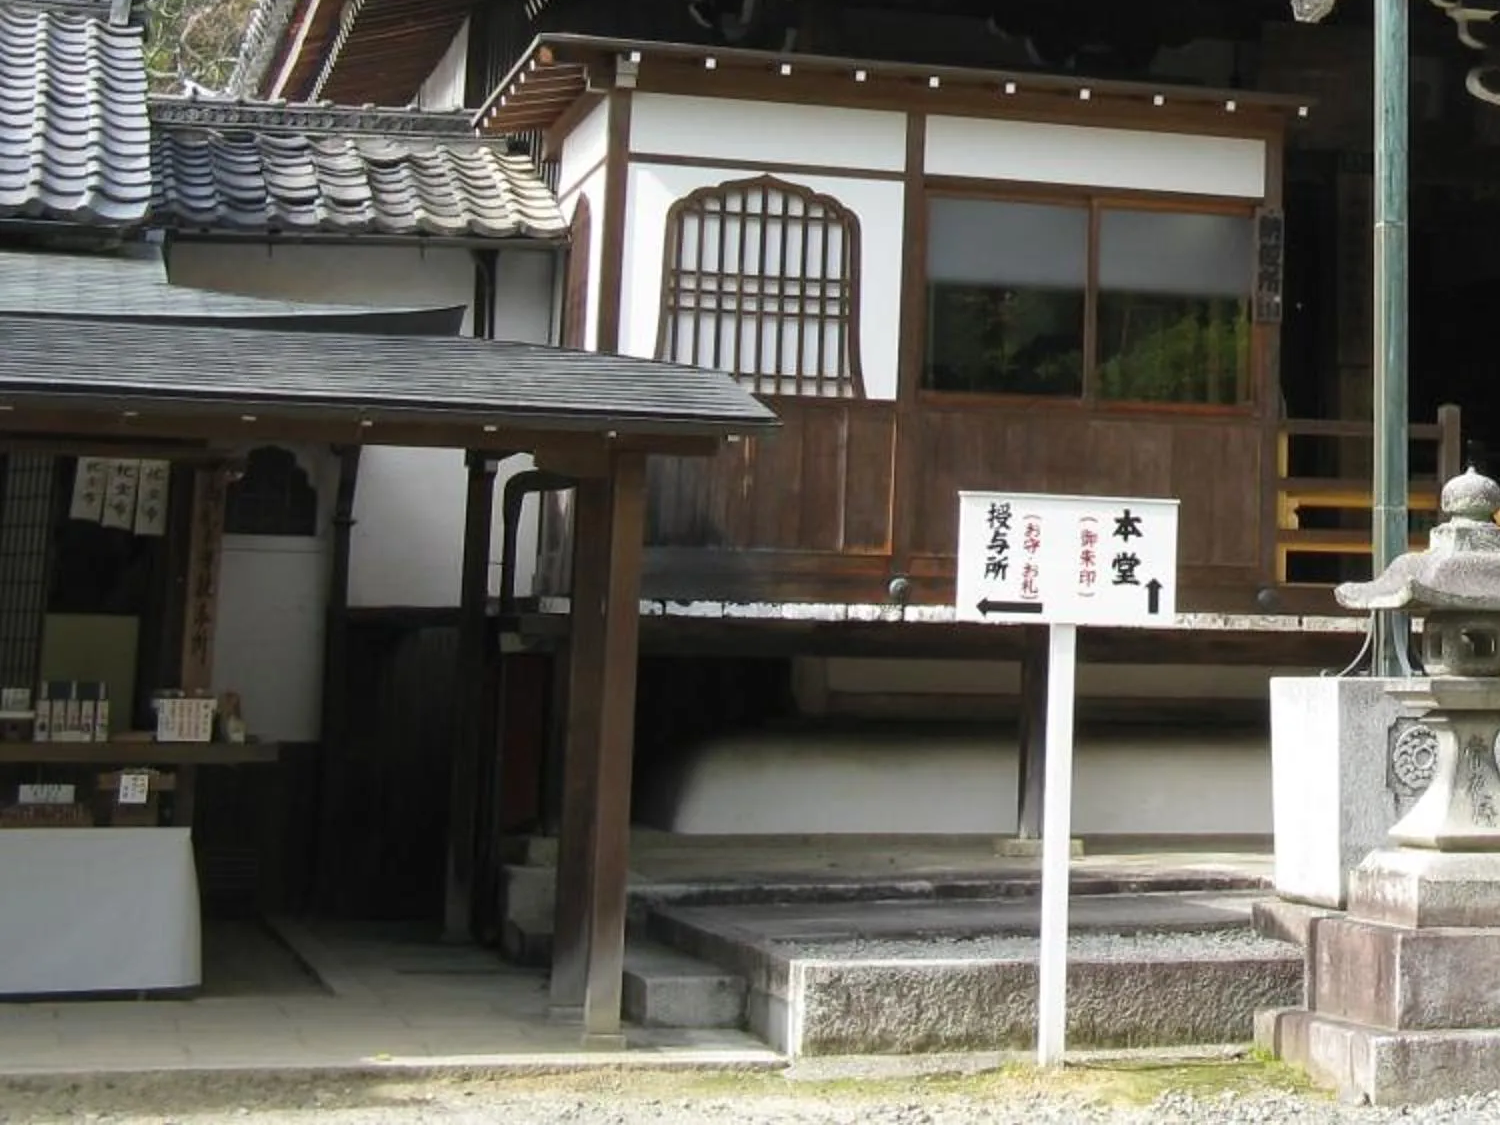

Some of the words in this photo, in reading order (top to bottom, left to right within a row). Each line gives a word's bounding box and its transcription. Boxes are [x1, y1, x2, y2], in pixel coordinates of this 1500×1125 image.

[984, 502, 1012, 581] 授与所
[1112, 509, 1143, 585] 本堂
